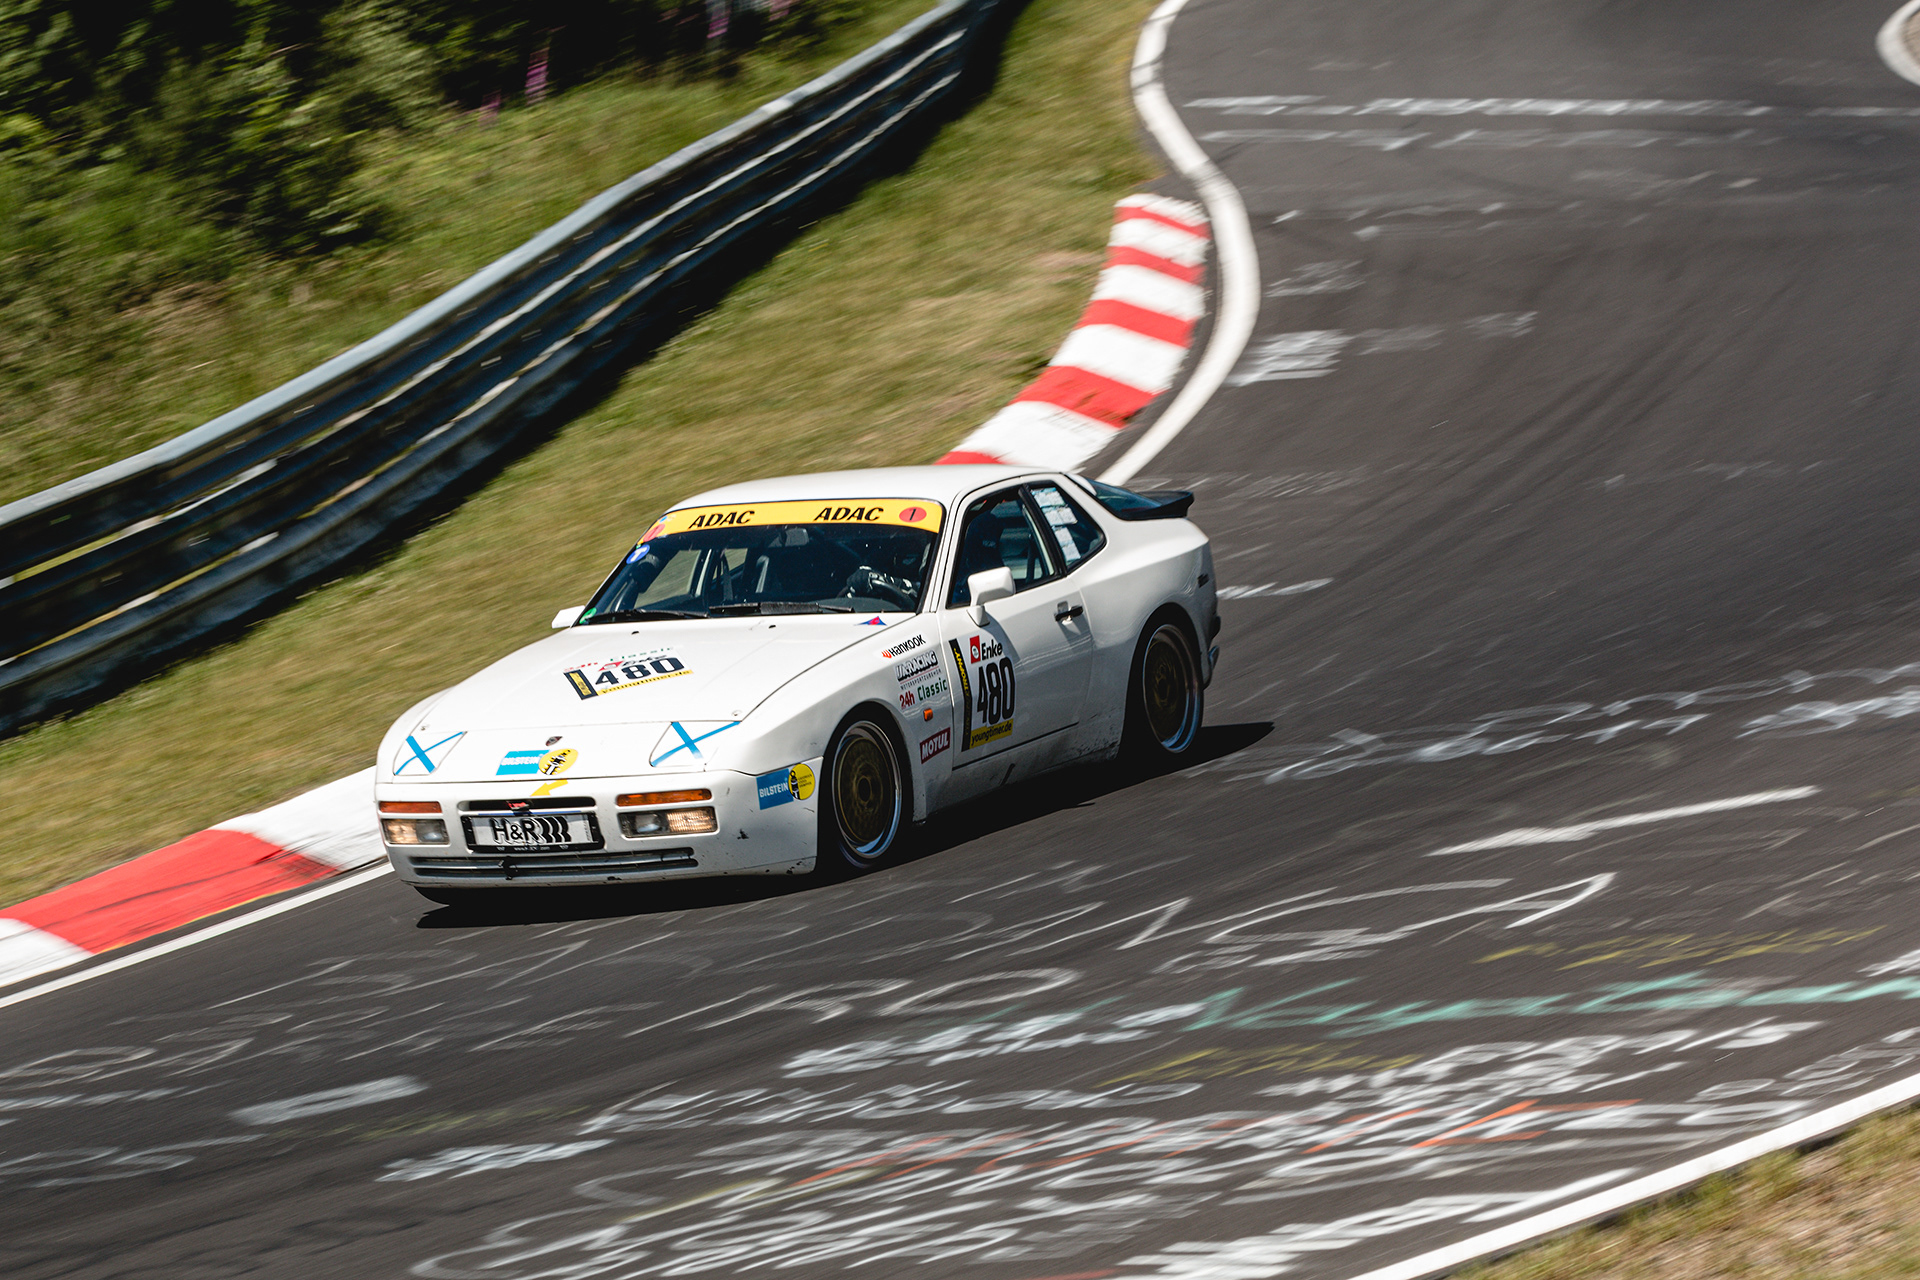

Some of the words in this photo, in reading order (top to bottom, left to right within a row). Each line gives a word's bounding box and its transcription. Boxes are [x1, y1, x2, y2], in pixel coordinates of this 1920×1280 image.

[687, 510, 755, 529] ADAC
[813, 507, 884, 521] ADAC
[981, 639, 1003, 660] Enke
[595, 657, 685, 685] 480
[900, 690, 915, 709] 24h
[917, 677, 948, 701] Classic
[977, 656, 1016, 725] 480
[971, 720, 1012, 746] youngtimer.de
[921, 731, 950, 761] MOTUL
[759, 782, 788, 798] BILSTEIN
[489, 817, 542, 841] H&R
